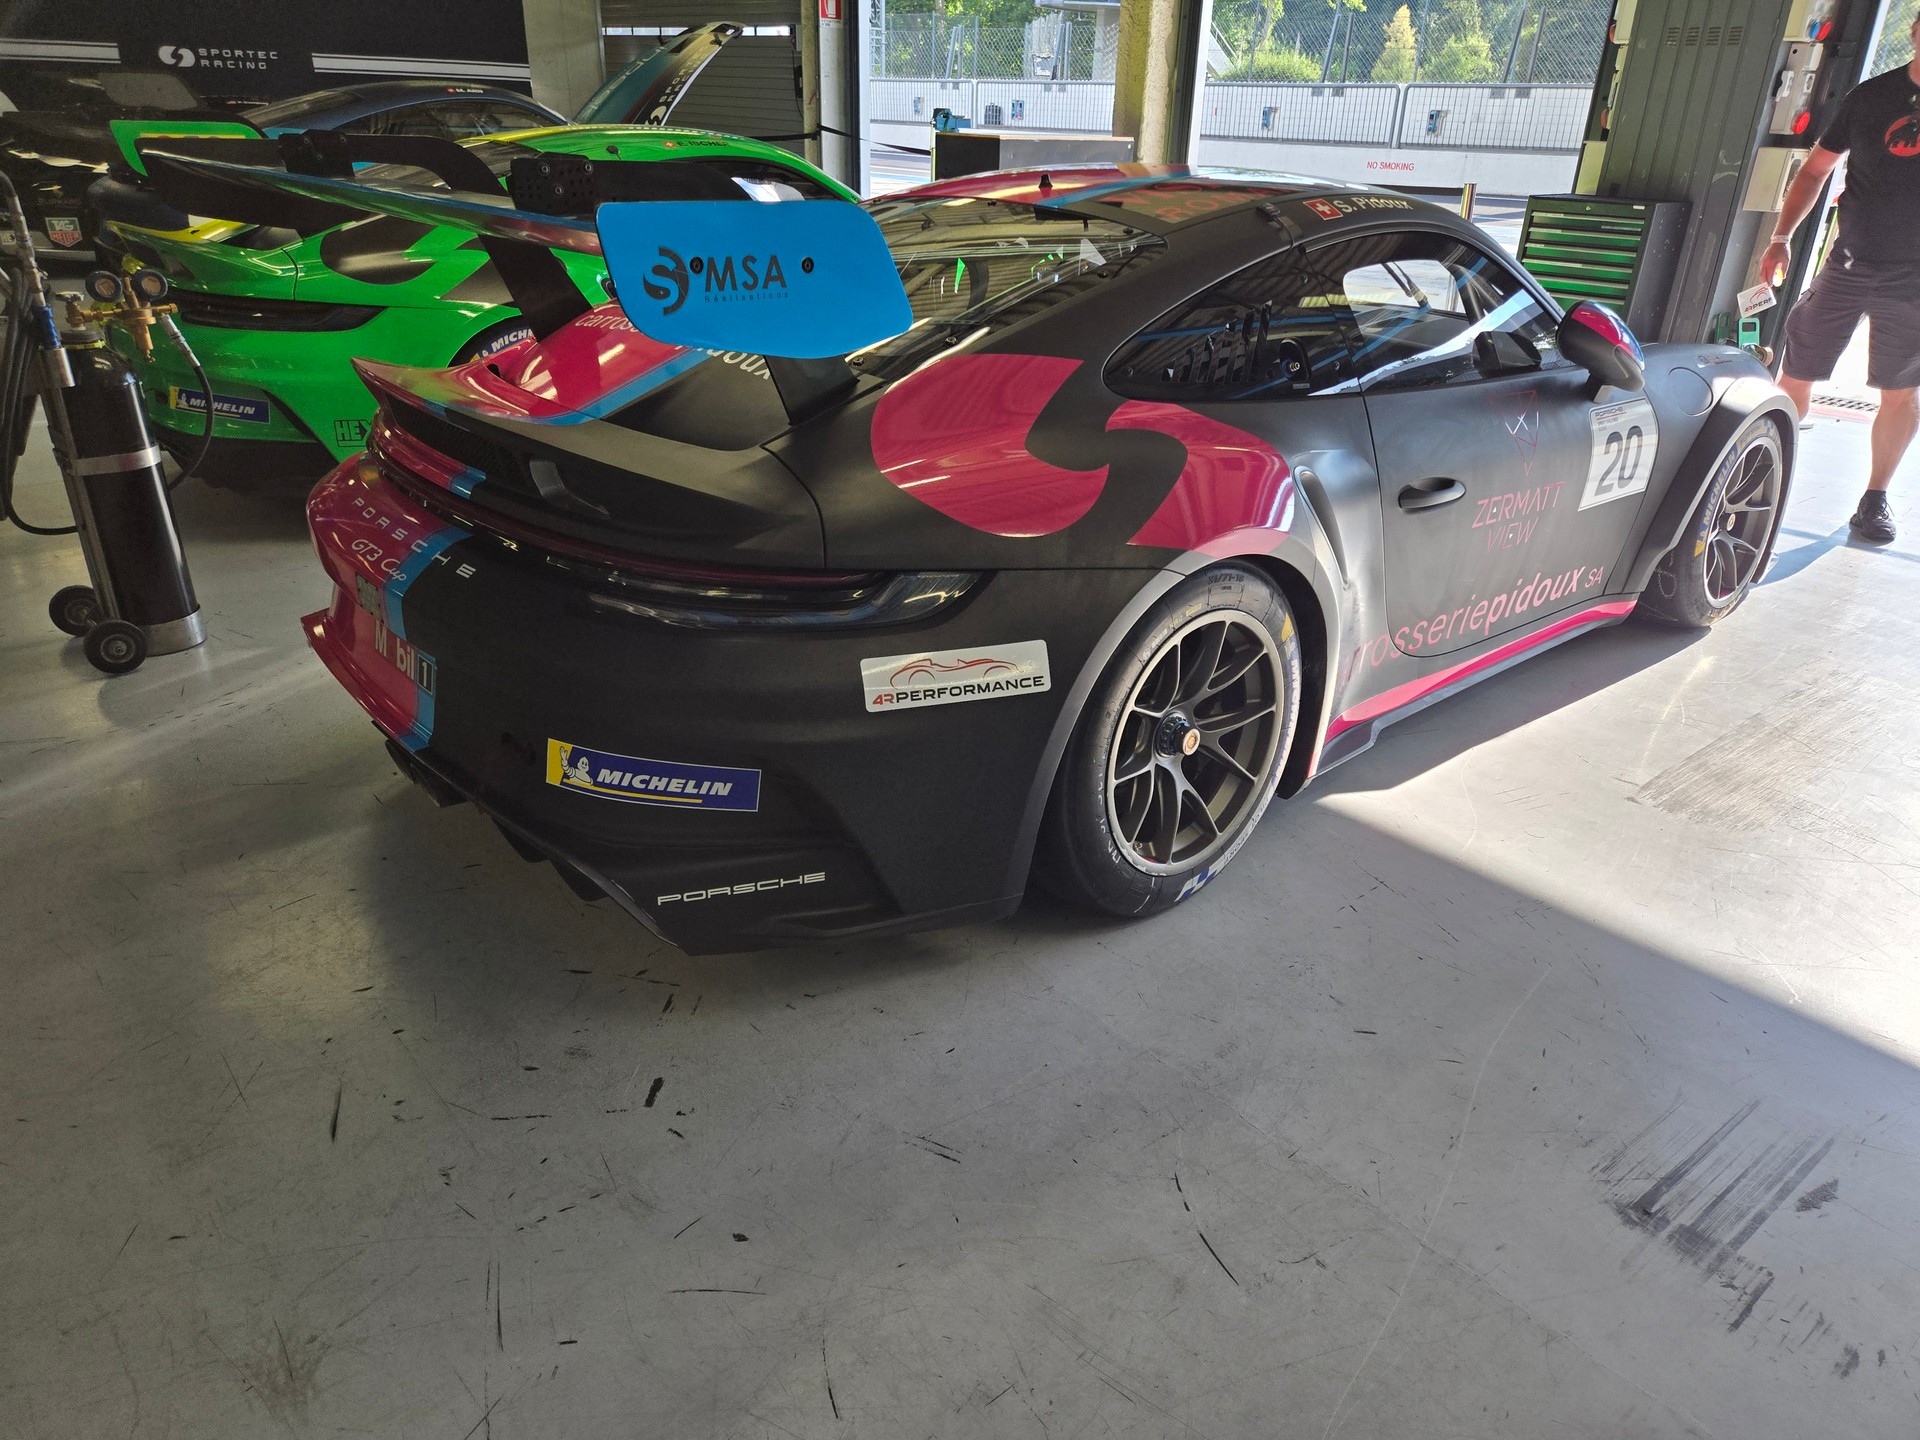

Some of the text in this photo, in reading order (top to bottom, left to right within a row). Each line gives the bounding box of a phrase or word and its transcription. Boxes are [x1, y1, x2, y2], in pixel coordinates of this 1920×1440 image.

[198, 48, 279, 60] SPORTEC
[200, 59, 268, 70] RACING
[1367, 161, 1415, 171] NO SMOKING
[1333, 196, 1414, 213] S. Pidoux
[51, 220, 74, 231] TAG
[705, 255, 787, 292] MSA
[704, 292, 789, 303] Réalisations
[1594, 425, 1644, 497] 20
[1471, 481, 1566, 529] ZERMATT
[352, 497, 477, 579] PORSCHE
[1487, 516, 1539, 552] VIEW
[351, 539, 407, 582] GT3 Cup
[1584, 566, 1605, 589] SA
[597, 768, 733, 796] MICHELIN
[657, 872, 826, 906] PORSCHE
